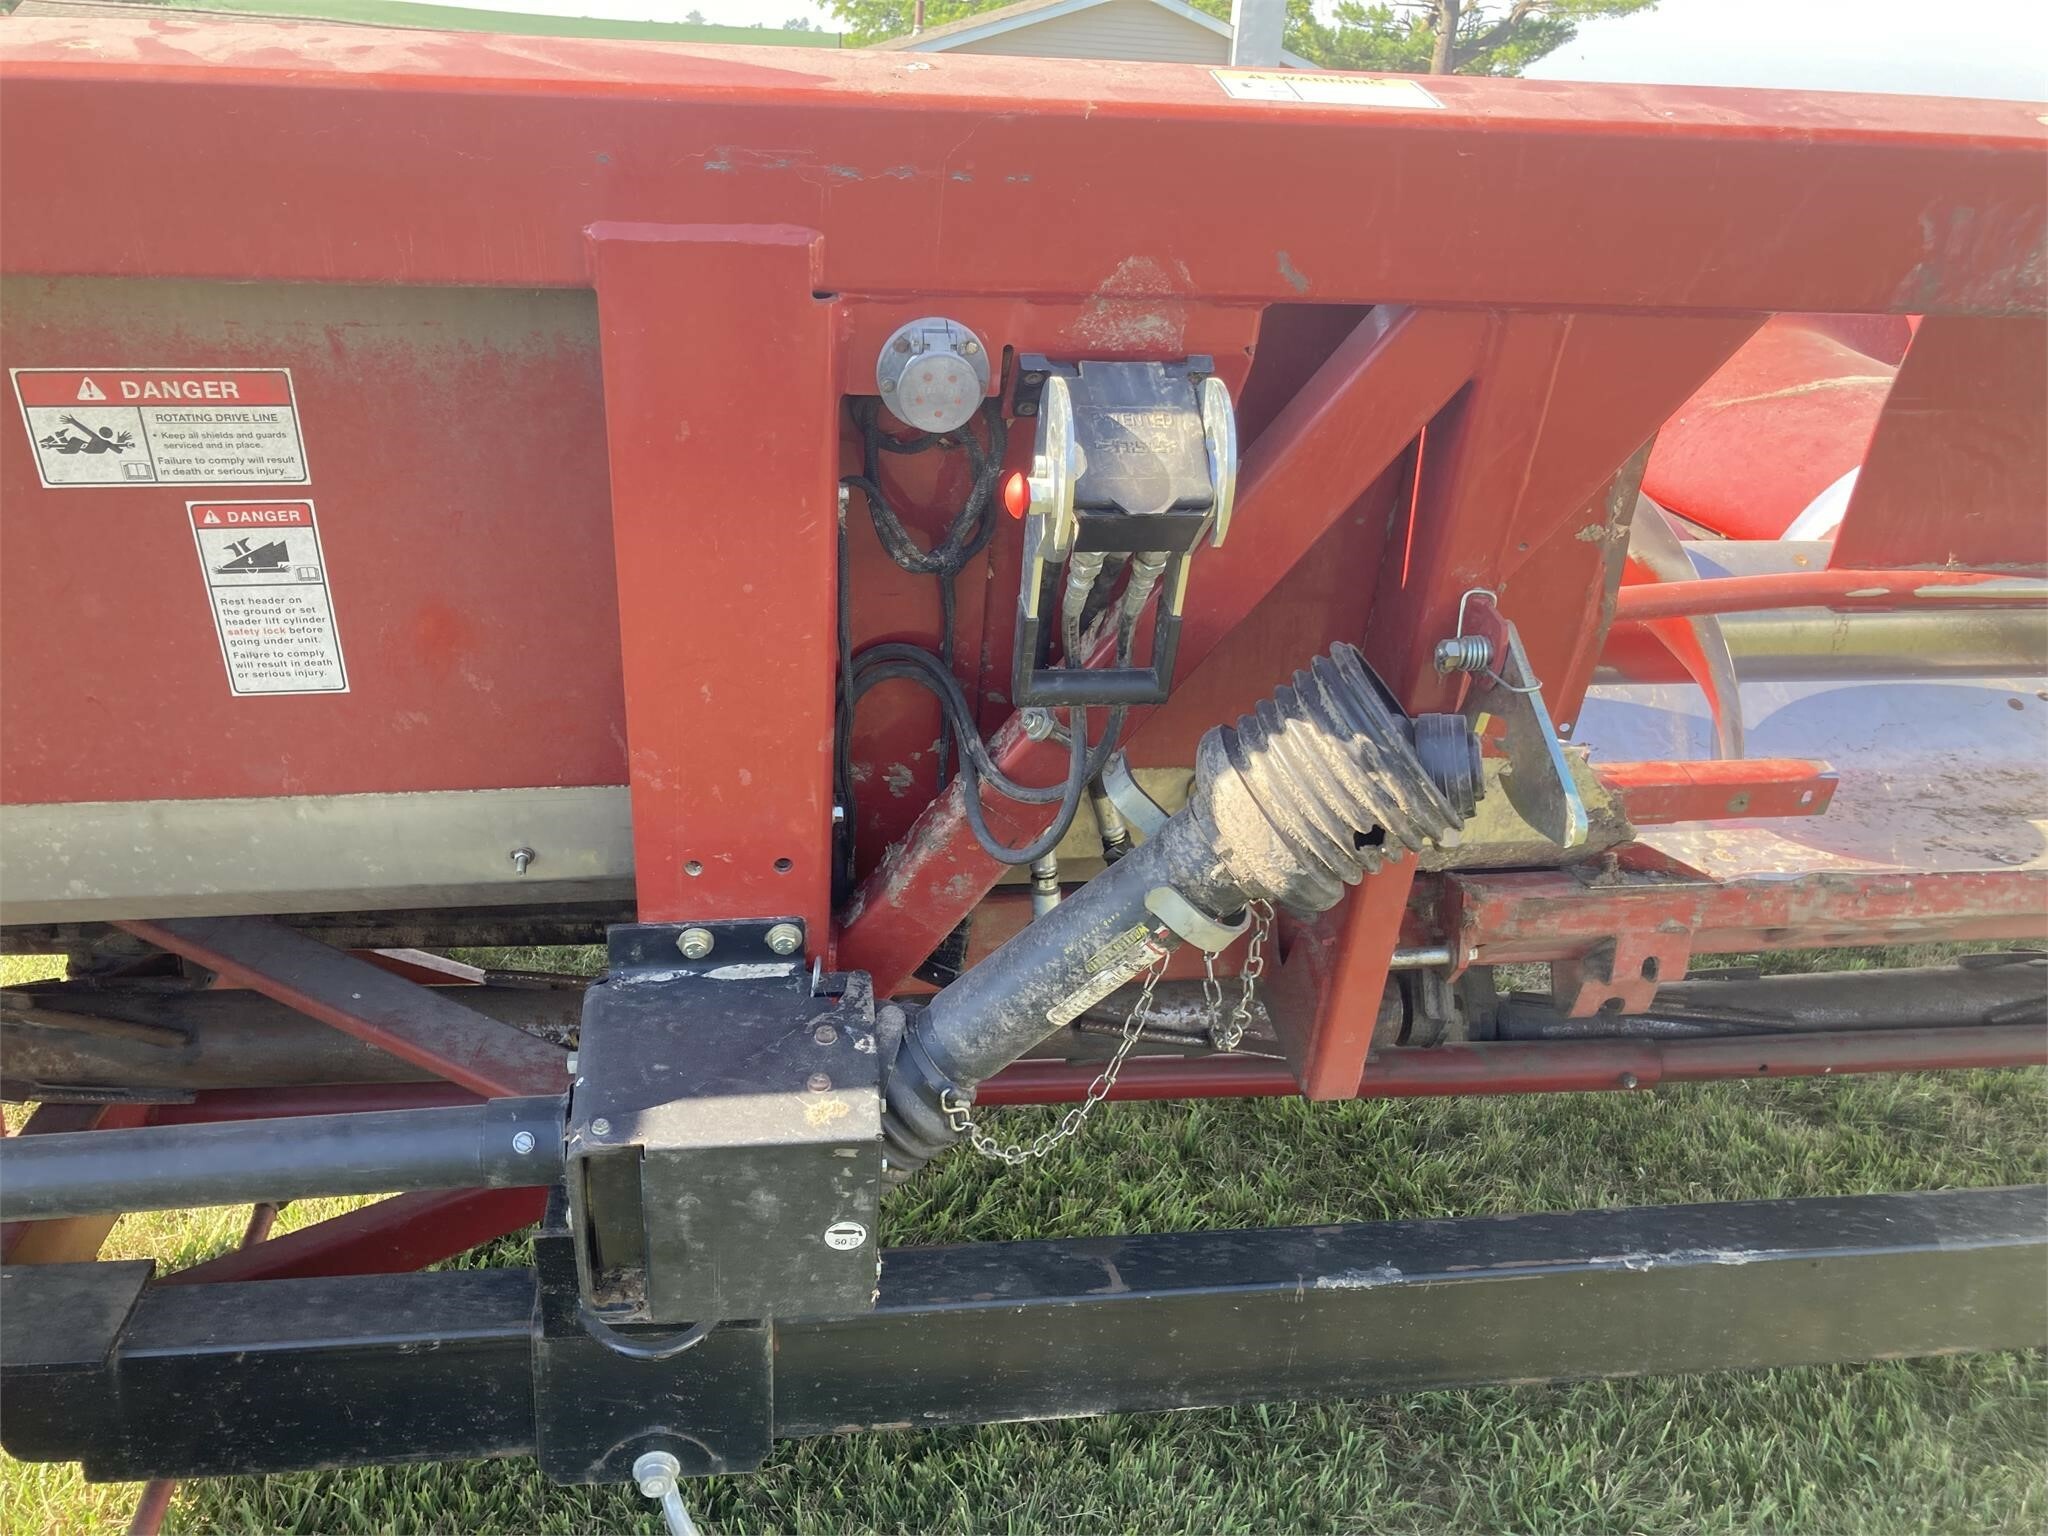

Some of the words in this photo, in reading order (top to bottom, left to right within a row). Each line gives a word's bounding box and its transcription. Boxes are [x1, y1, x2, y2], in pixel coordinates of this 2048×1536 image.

[121, 381, 239, 398] DANGER
[155, 413, 213, 422] ROTATING
[215, 413, 250, 422] DRIVE
[252, 413, 278, 422] LINE
[161, 432, 186, 440] Keep
[255, 432, 287, 440] guards
[163, 441, 203, 449] serviced
[206, 441, 223, 449] and
[225, 441, 234, 449] in
[236, 441, 264, 450] place.
[157, 456, 192, 465] Failure
[194, 457, 206, 465] to
[208, 457, 245, 466] comply
[246, 456, 264, 464] will
[266, 456, 296, 464] result
[160, 468, 170, 476] in
[172, 467, 202, 476] death
[217, 467, 254, 475] serious
[256, 467, 288, 476] injury.
[226, 510, 301, 523] DANGER
[248, 597, 285, 605] header
[222, 608, 240, 616] the
[243, 607, 282, 617] ground
[300, 606, 317, 614] set
[225, 618, 262, 626] header
[265, 617, 280, 625] lift
[283, 616, 326, 625] cylinder
[227, 627, 260, 636] safety
[263, 627, 287, 635] lock
[230, 638, 260, 647] going
[263, 637, 294, 645] under
[297, 636, 321, 644] unit.
[287, 650, 325, 659] comply
[304, 659, 333, 667] death
[238, 671, 249, 679] or
[252, 670, 291, 678] serious
[294, 670, 328, 678] injury.
